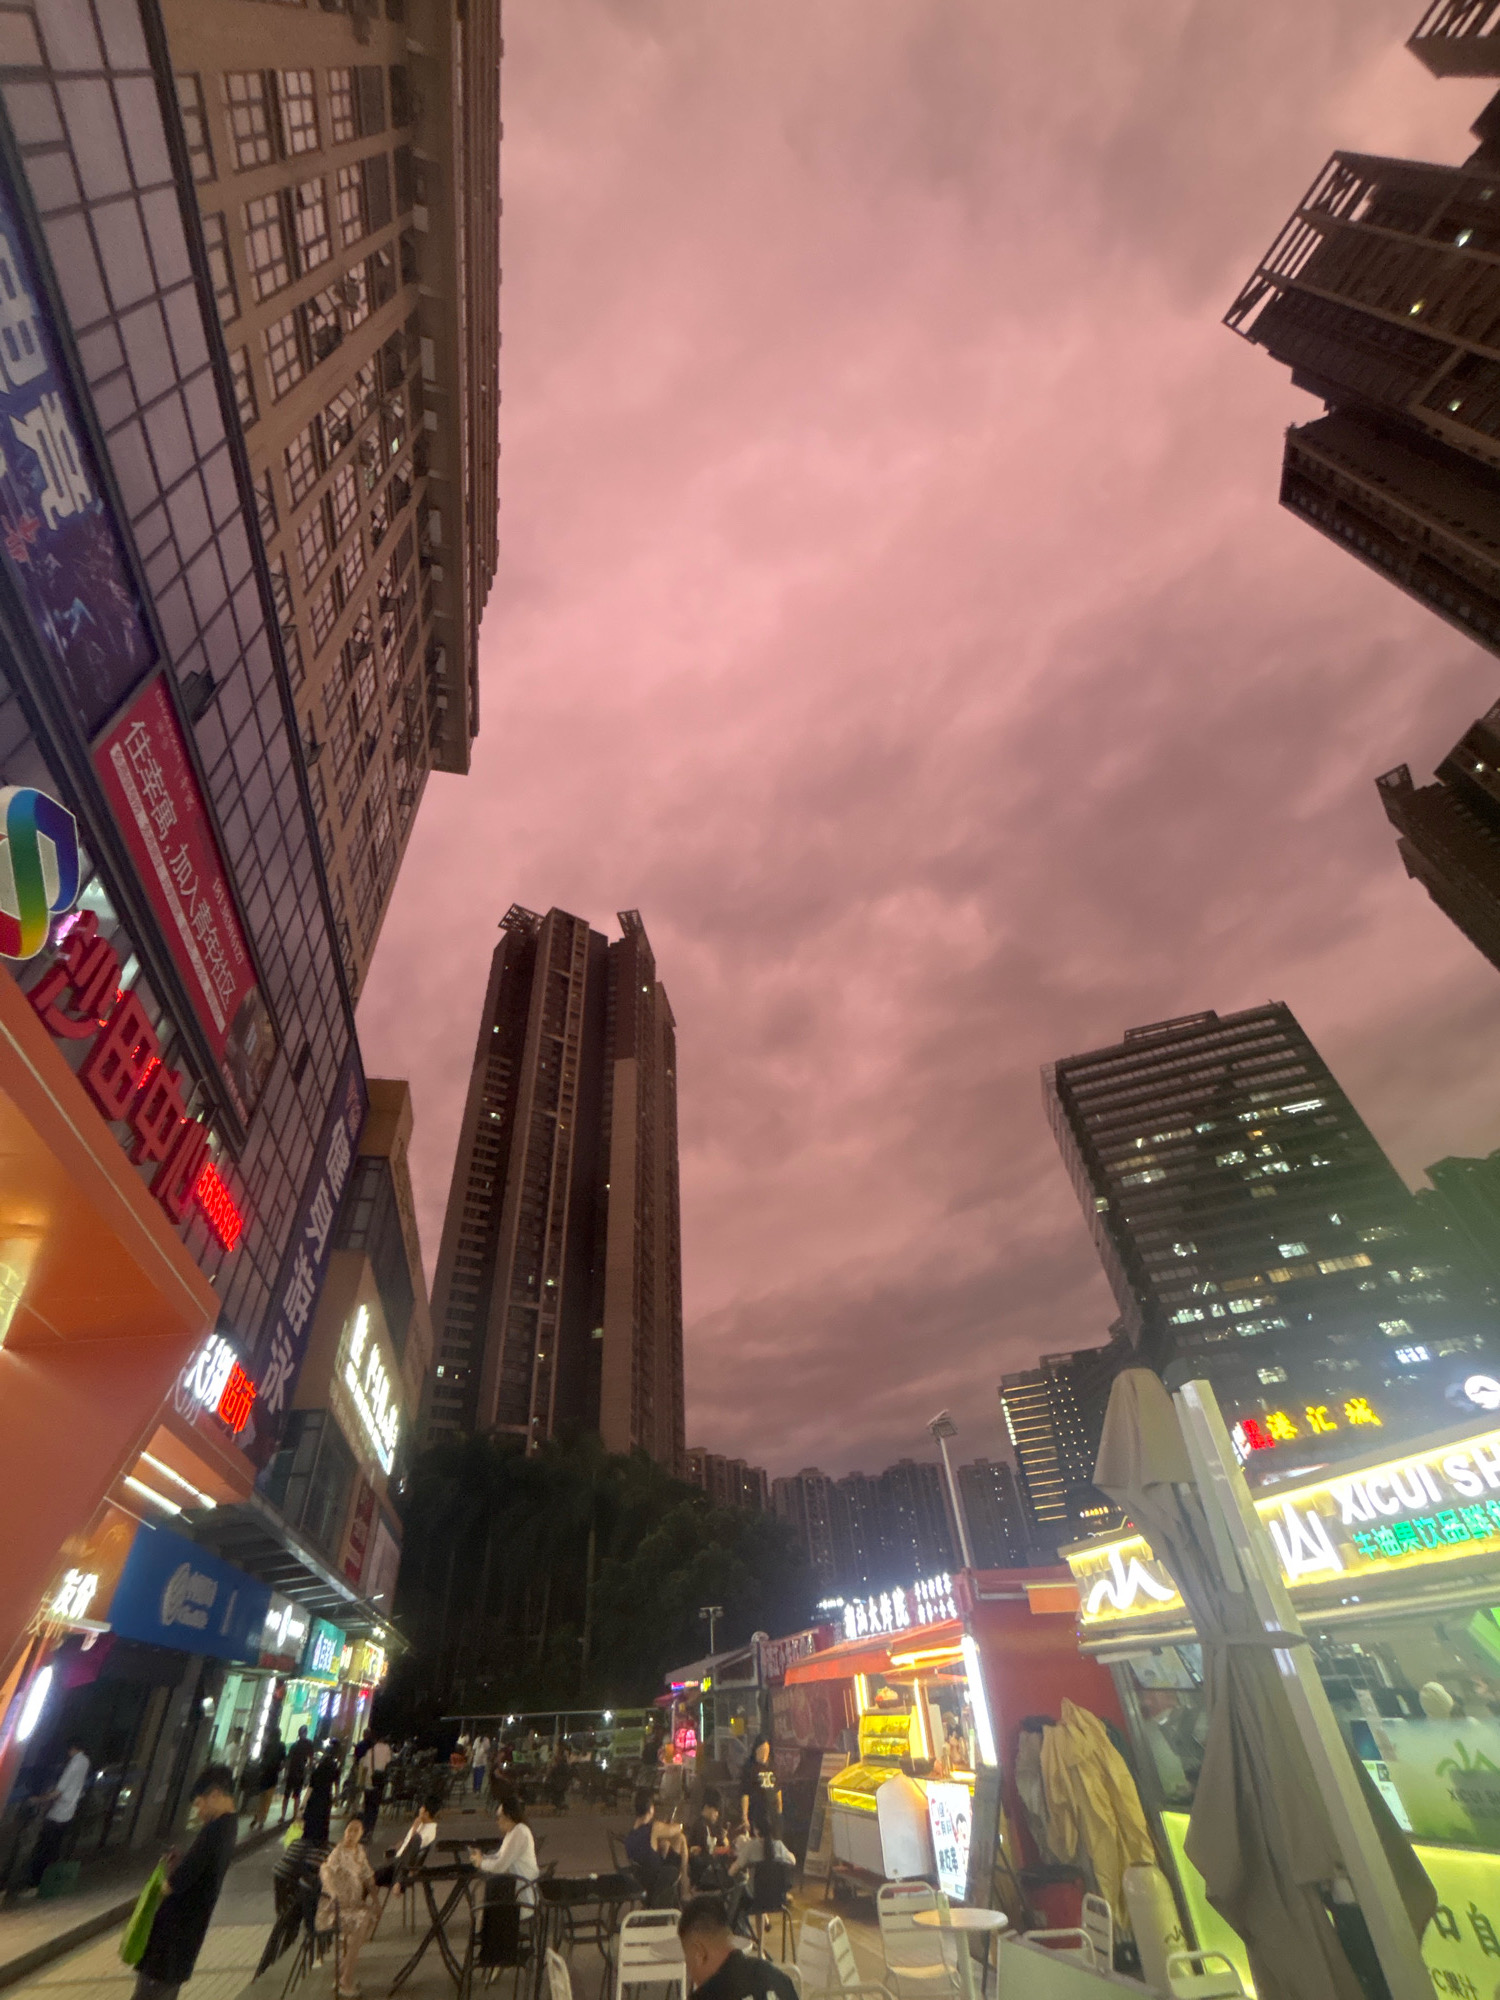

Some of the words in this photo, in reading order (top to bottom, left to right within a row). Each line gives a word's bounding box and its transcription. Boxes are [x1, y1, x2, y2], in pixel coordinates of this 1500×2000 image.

[262, 1116, 350, 1413] 健身游泳
[1329, 1464, 1442, 1525] XICUI
